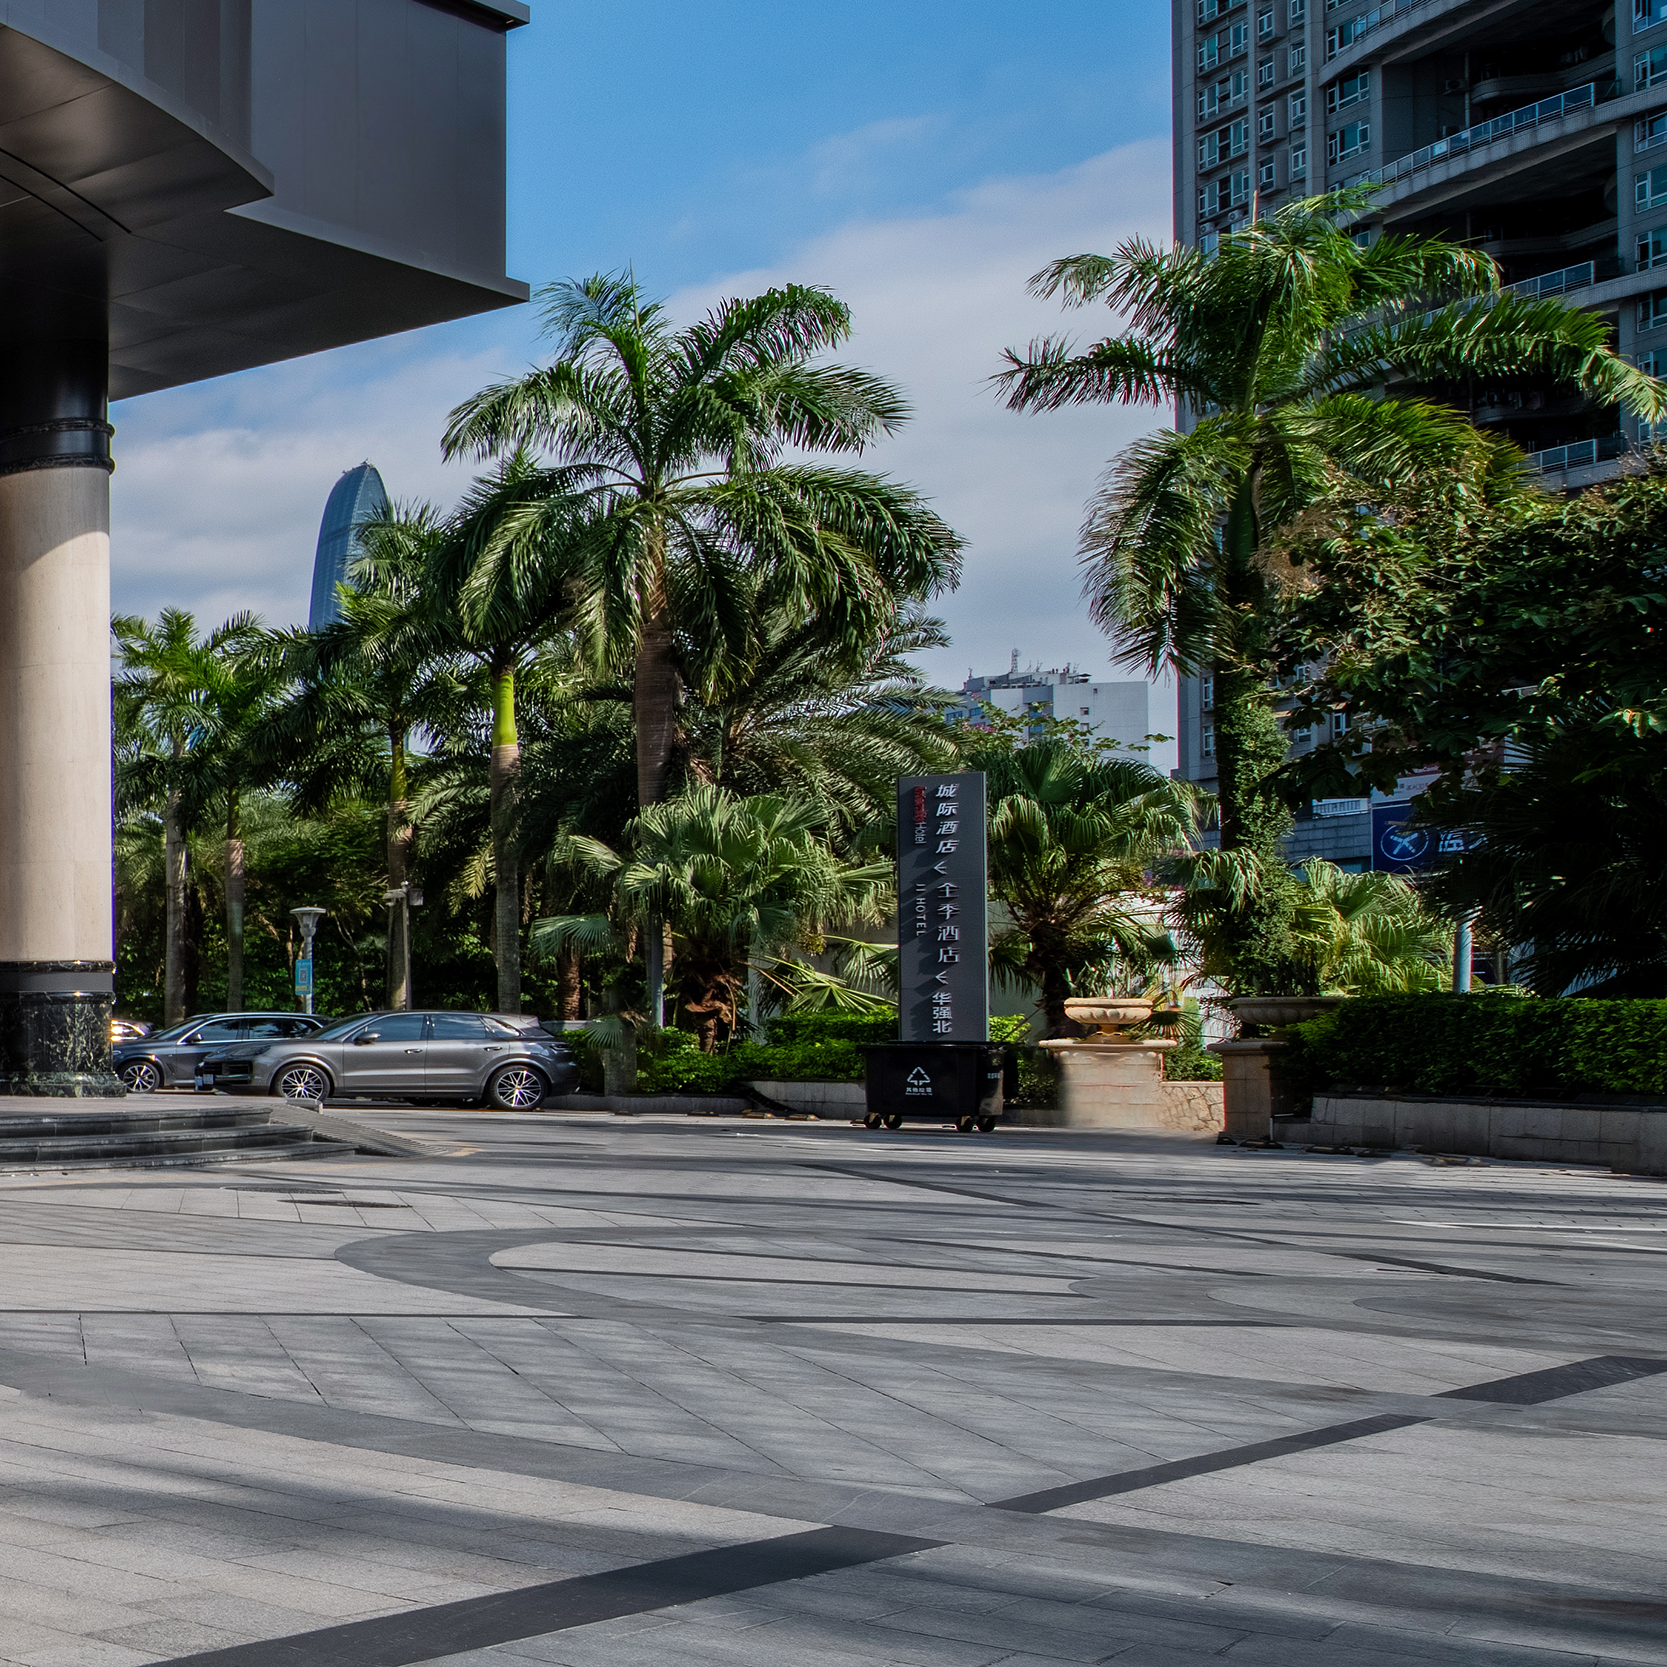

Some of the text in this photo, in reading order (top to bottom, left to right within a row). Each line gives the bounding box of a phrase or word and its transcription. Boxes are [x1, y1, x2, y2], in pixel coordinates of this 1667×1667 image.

[935, 783, 960, 854] 城际酒店
[915, 897, 927, 936] HOTEL
[937, 882, 961, 963] 全季酒店
[932, 992, 953, 1034] 华强北
